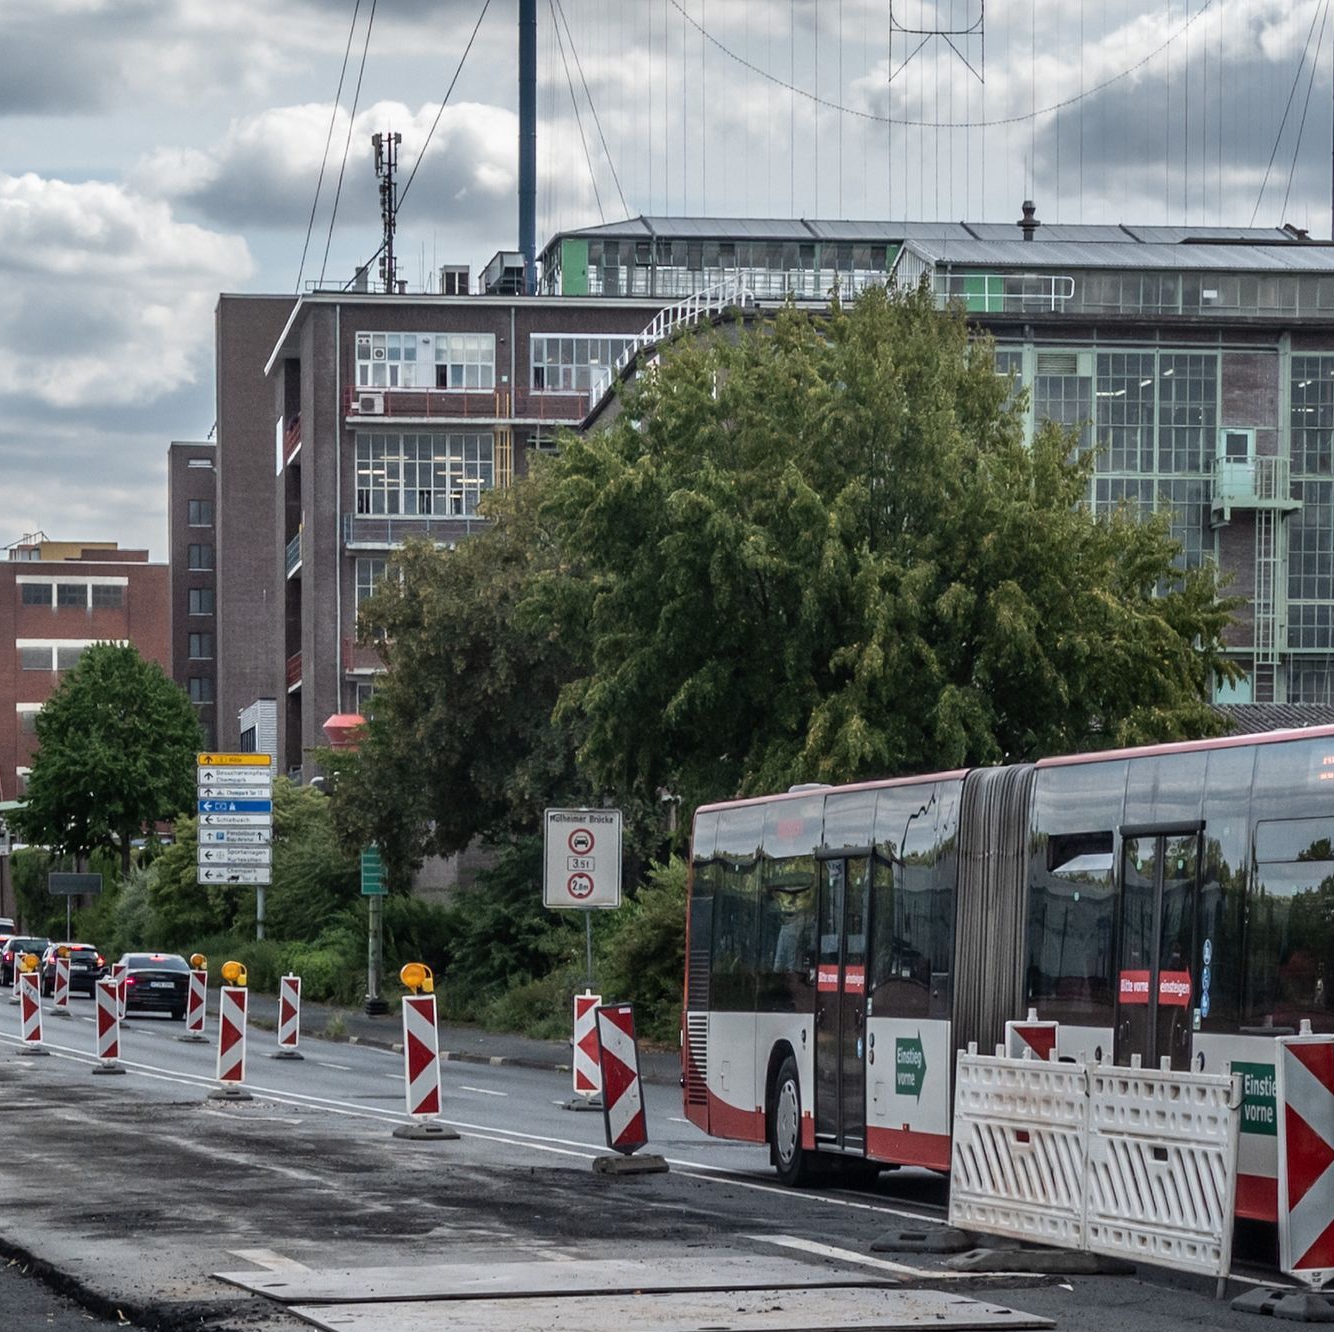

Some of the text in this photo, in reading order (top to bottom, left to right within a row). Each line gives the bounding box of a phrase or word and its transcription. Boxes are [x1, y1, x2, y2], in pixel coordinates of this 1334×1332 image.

[1120, 979, 1190, 997] Bitte vorne einsteigen
[897, 1047, 922, 1069] Einstieg
[897, 1073, 916, 1086] vorne
[1244, 1073, 1277, 1097] Einstie
[1244, 1103, 1274, 1123] vorne
